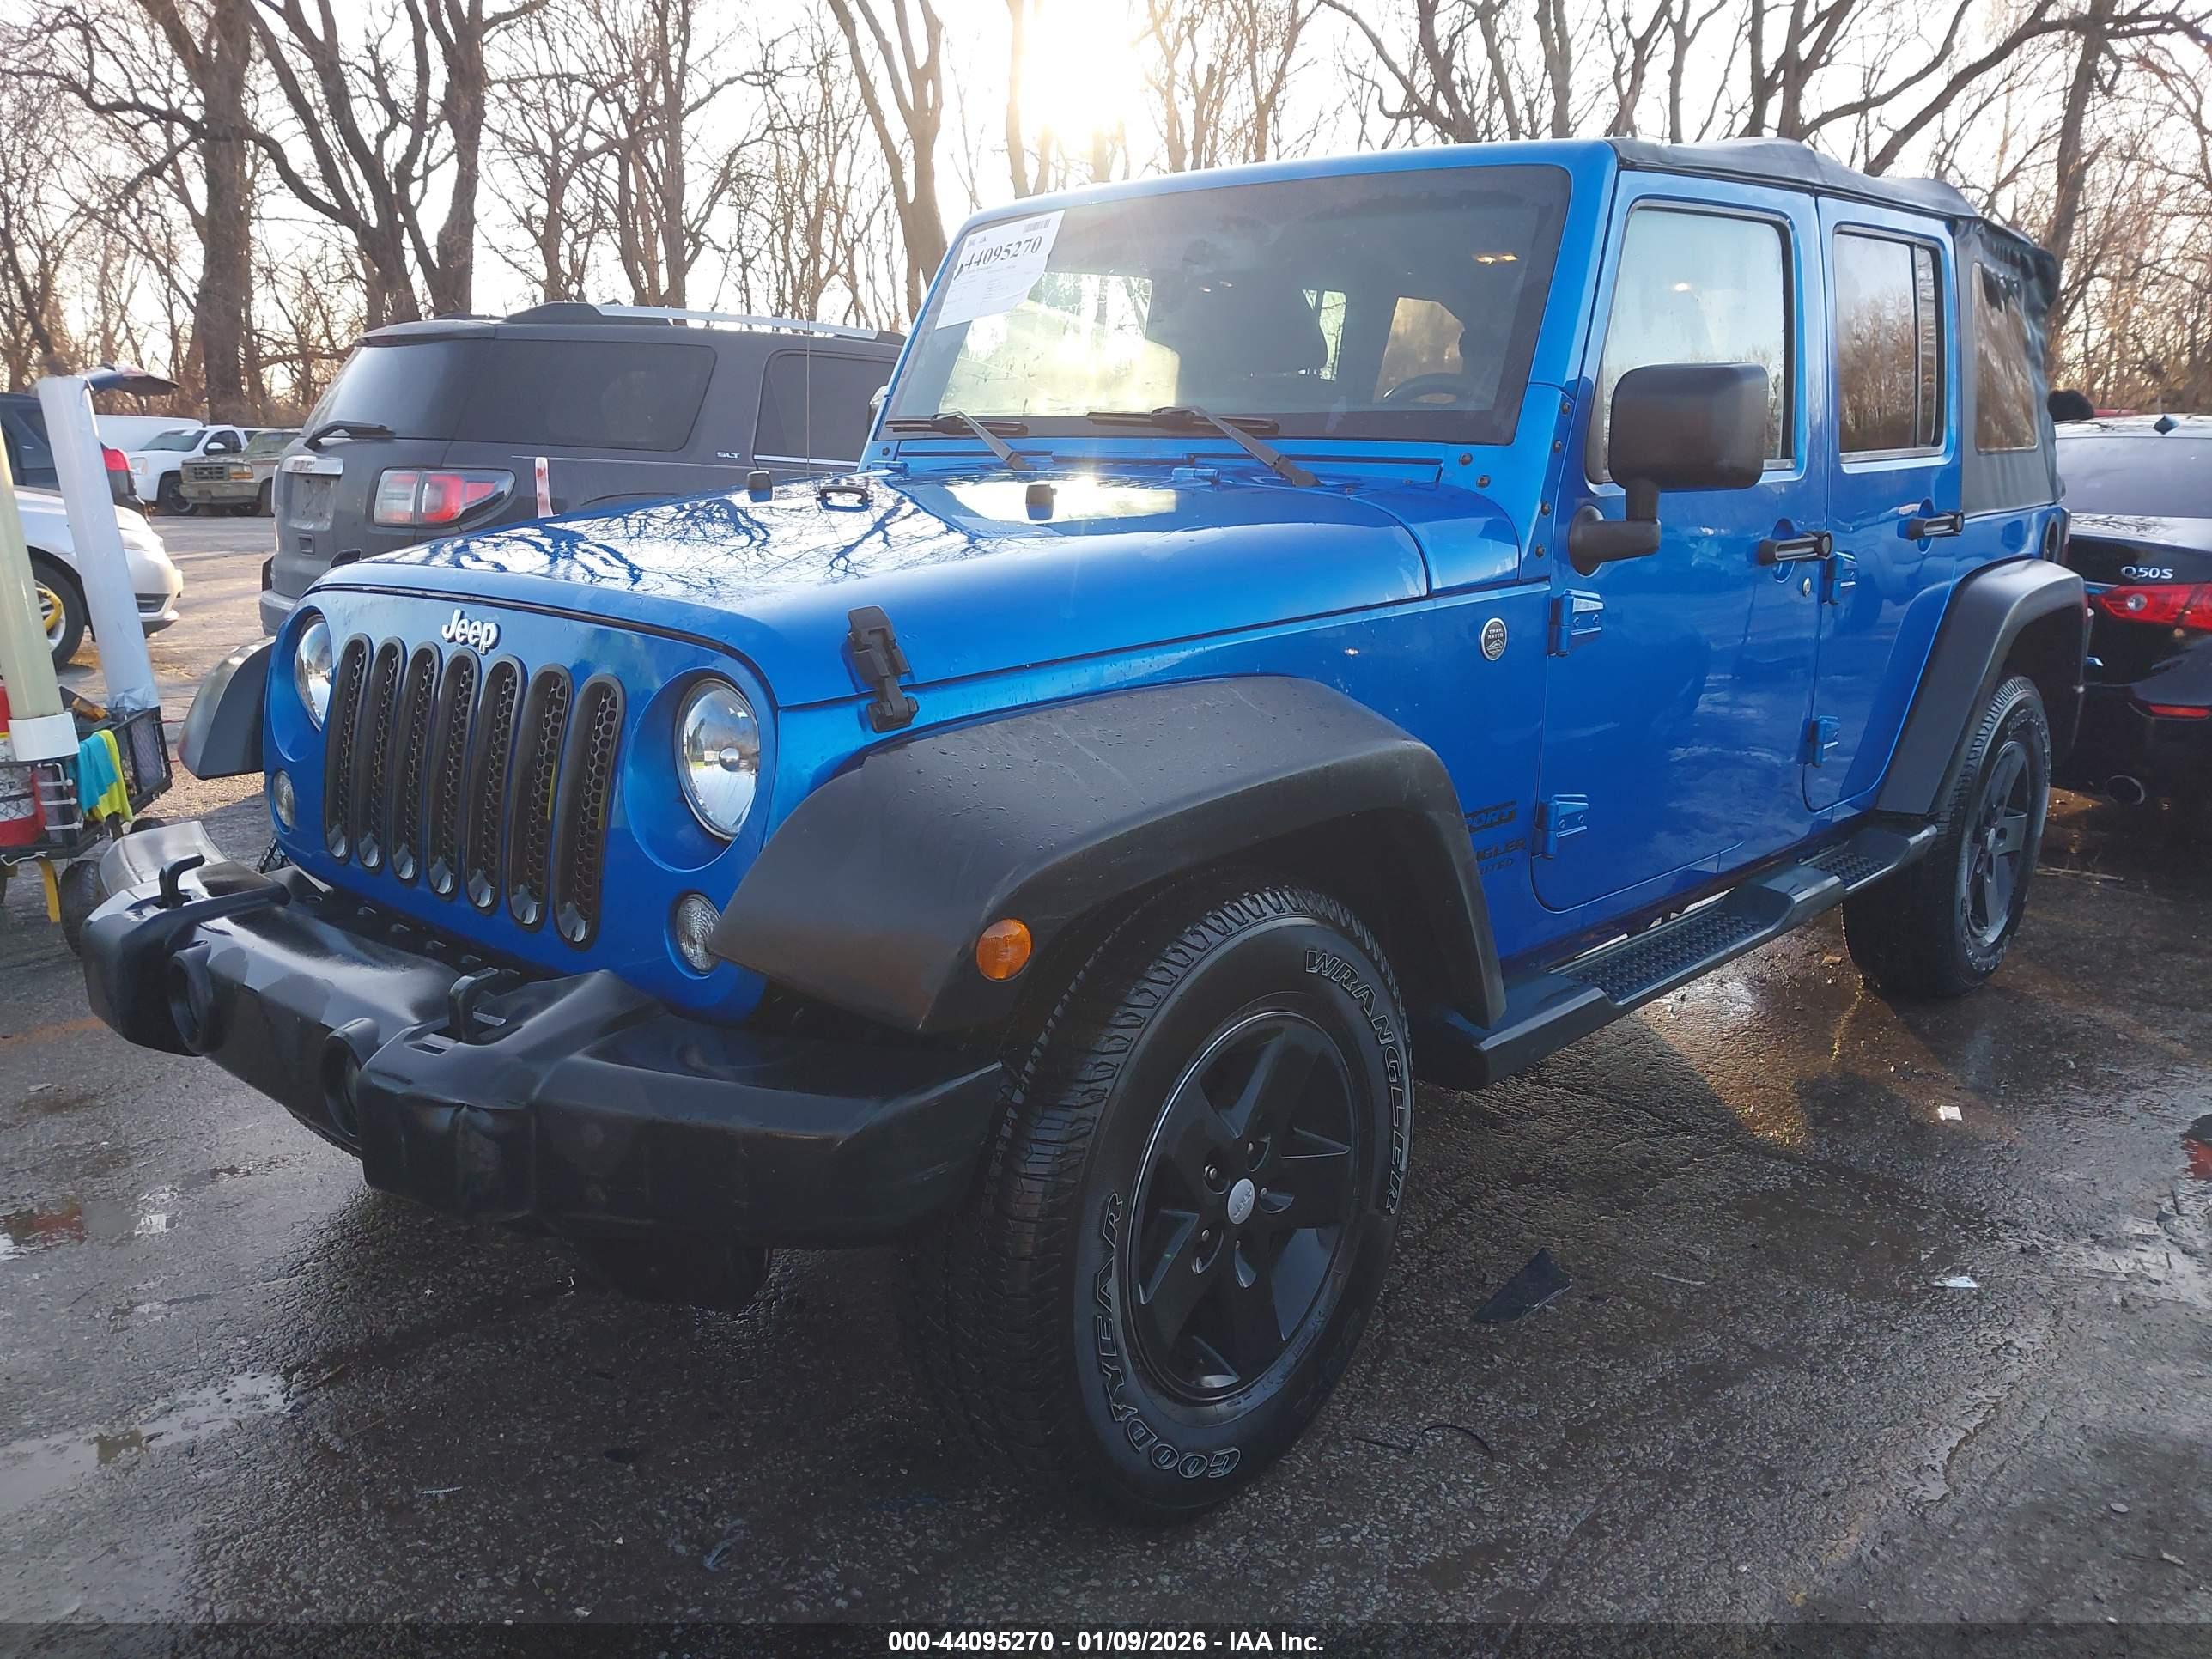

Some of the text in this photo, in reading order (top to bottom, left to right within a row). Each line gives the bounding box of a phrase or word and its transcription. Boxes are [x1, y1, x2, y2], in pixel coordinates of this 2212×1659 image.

[441, 608, 501, 655] Jeep
[2120, 565, 2174, 580] Q50S
[1305, 949, 1407, 1215] WRANGLER
[1097, 1192, 1242, 1479] GOODYEAR
